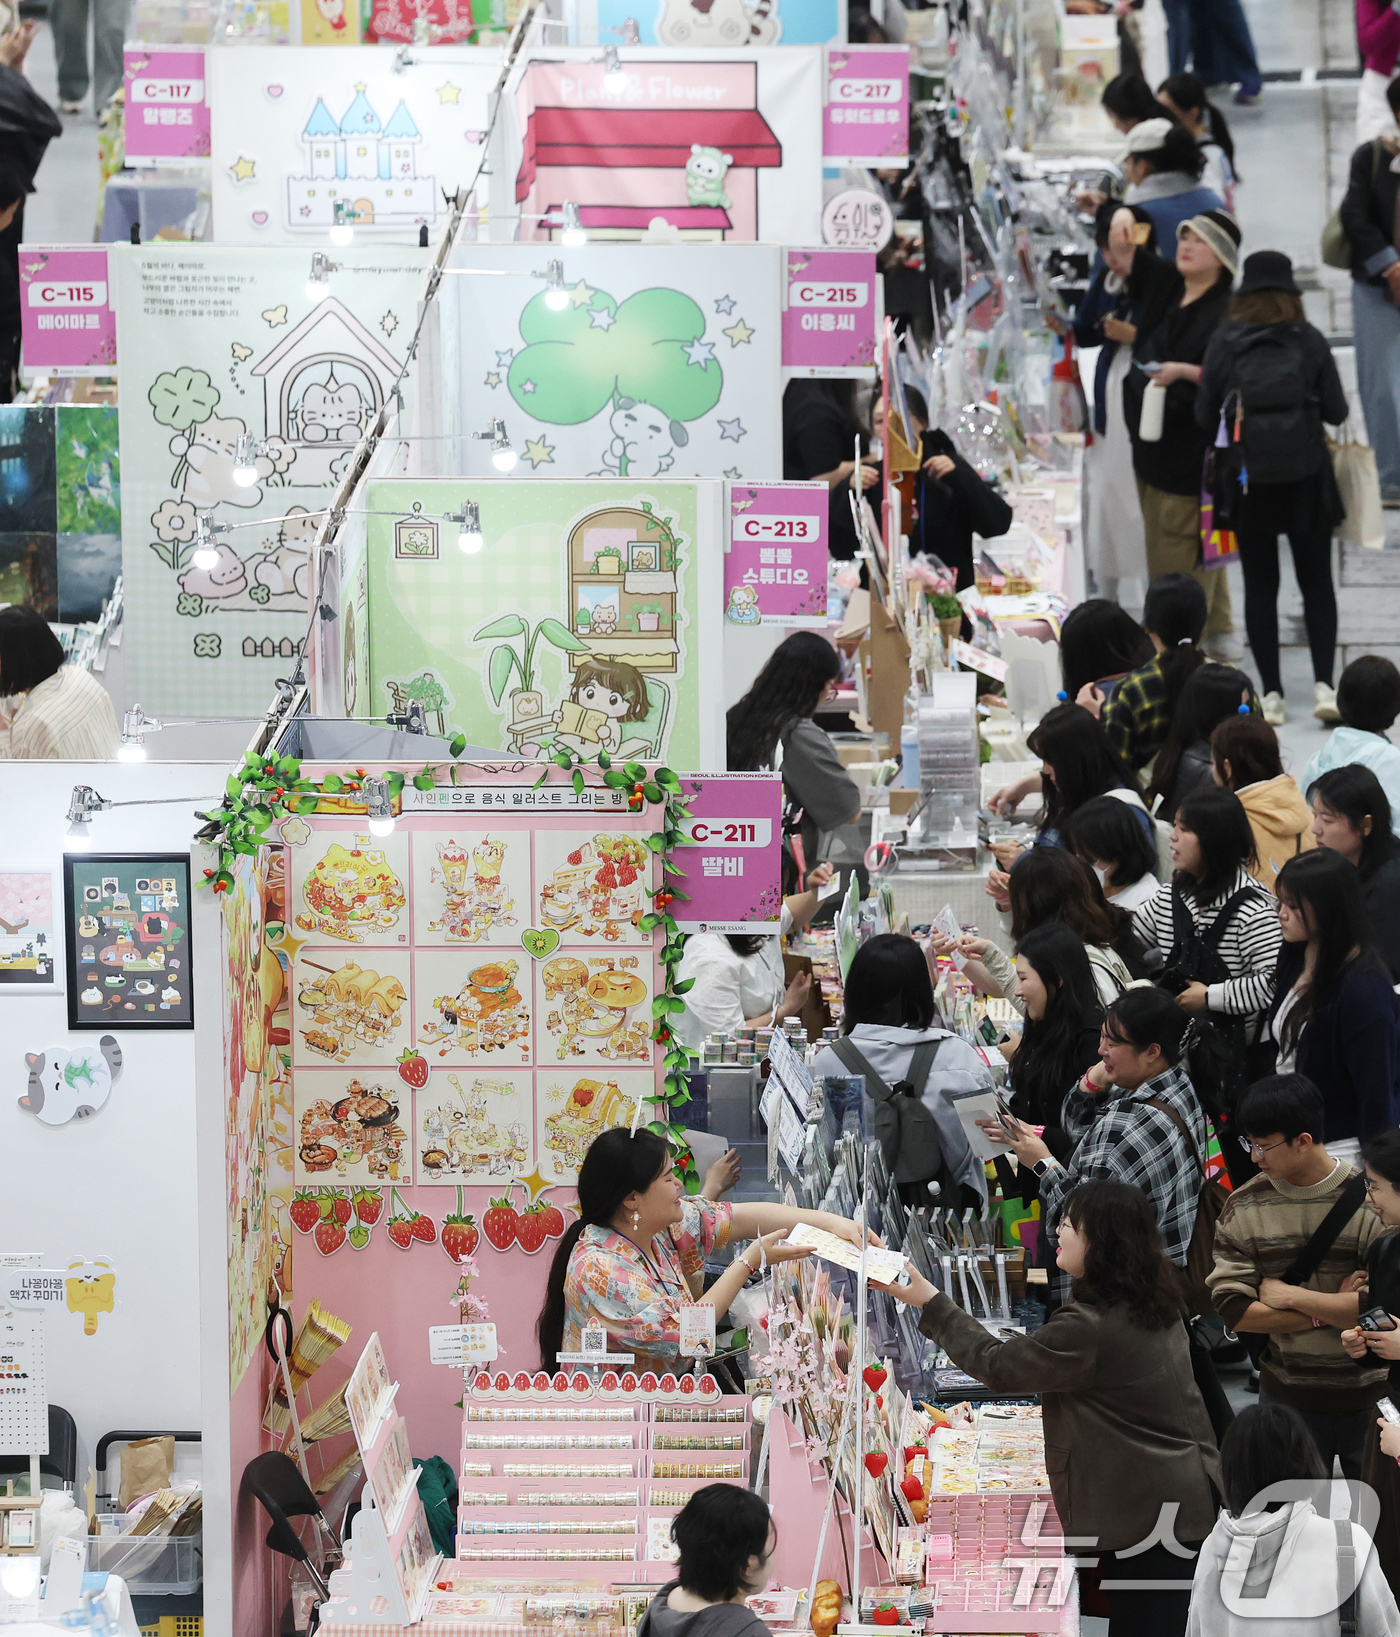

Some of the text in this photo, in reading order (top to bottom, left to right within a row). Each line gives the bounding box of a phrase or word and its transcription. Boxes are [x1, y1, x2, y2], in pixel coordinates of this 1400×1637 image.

[144, 84, 191, 98] C-117
[649, 76, 727, 101] Flower
[840, 84, 891, 98] C-217
[41, 287, 94, 301] C-115
[800, 287, 857, 302] C-215
[37, 314, 100, 330] 메이마르
[745, 520, 807, 537] C-213
[742, 567, 809, 585] 스튜디오
[412, 793, 624, 805] 사인펜으로 음식 일러스트 그리는 방
[691, 823, 755, 842] C-211
[702, 856, 744, 877] 딸비
[10, 1290, 63, 1301] 액자 꾸미기
